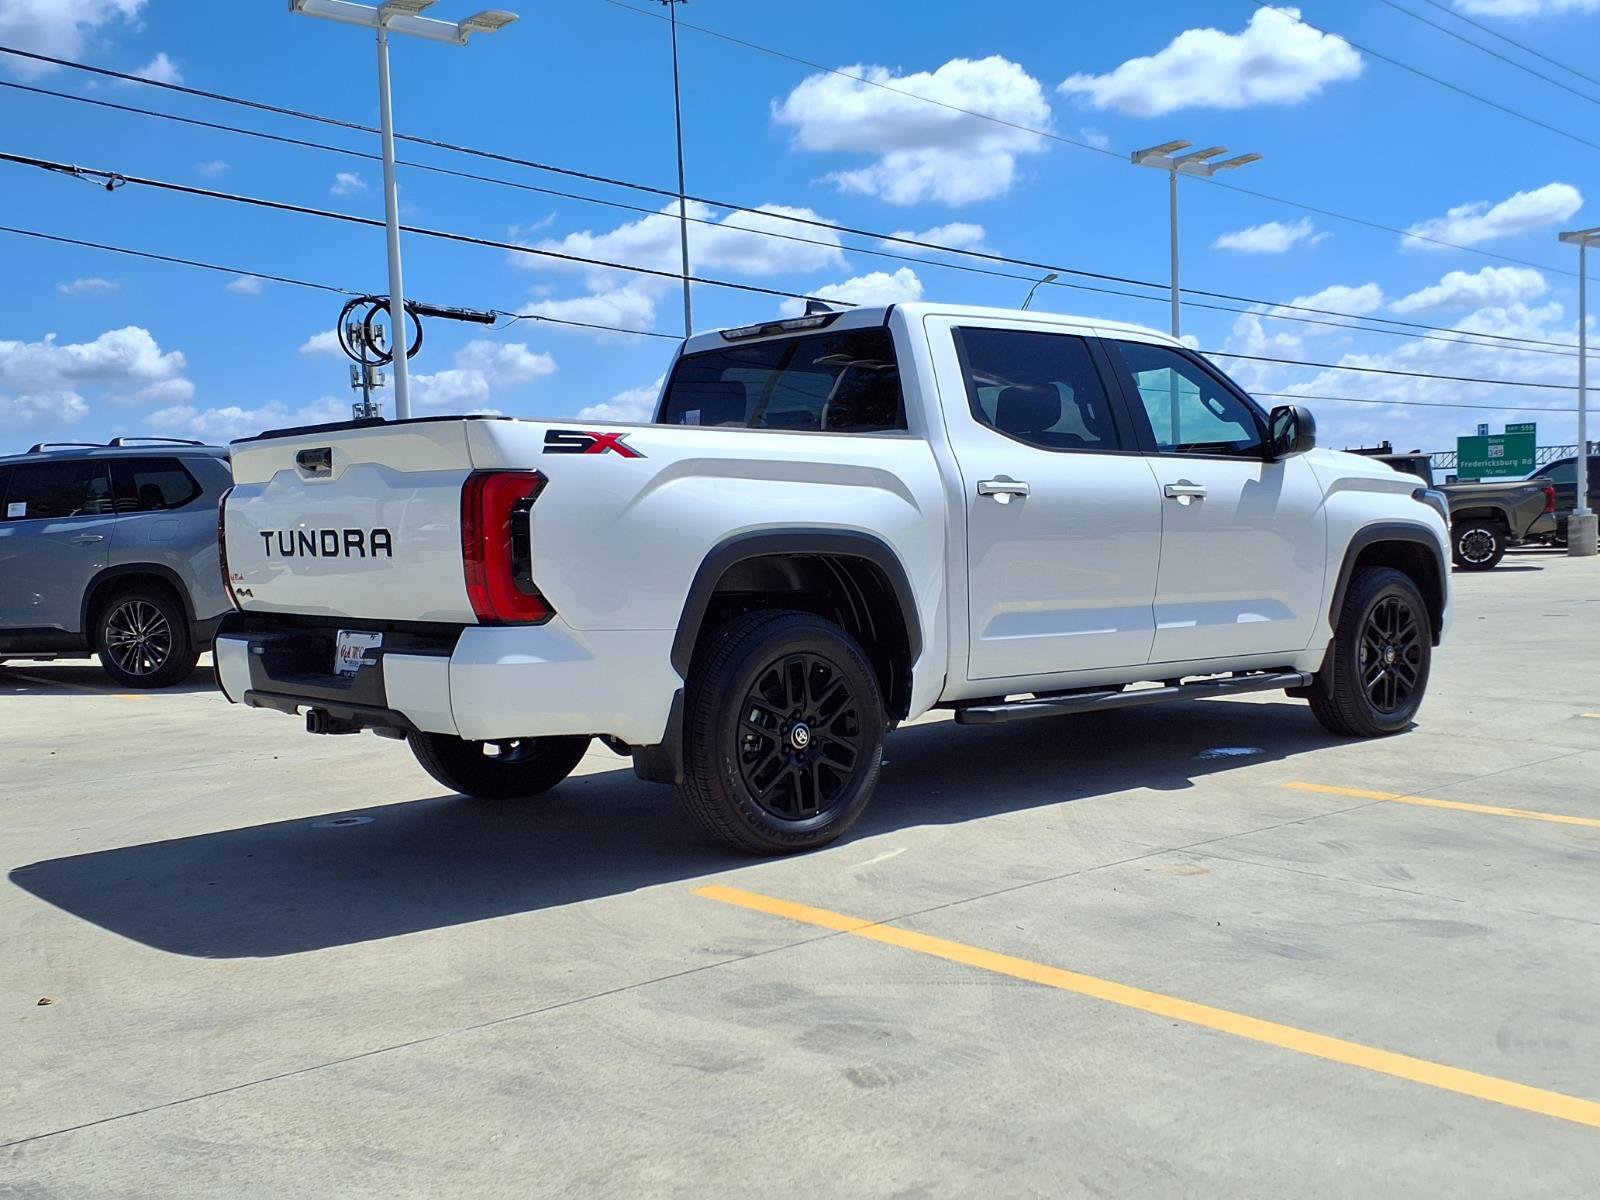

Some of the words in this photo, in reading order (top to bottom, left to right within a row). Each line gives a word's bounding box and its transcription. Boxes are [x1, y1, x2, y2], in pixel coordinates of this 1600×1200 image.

[542, 429, 648, 458] SX
[1461, 459, 1518, 468] Fredericksburg
[260, 528, 393, 557] TUNDRA
